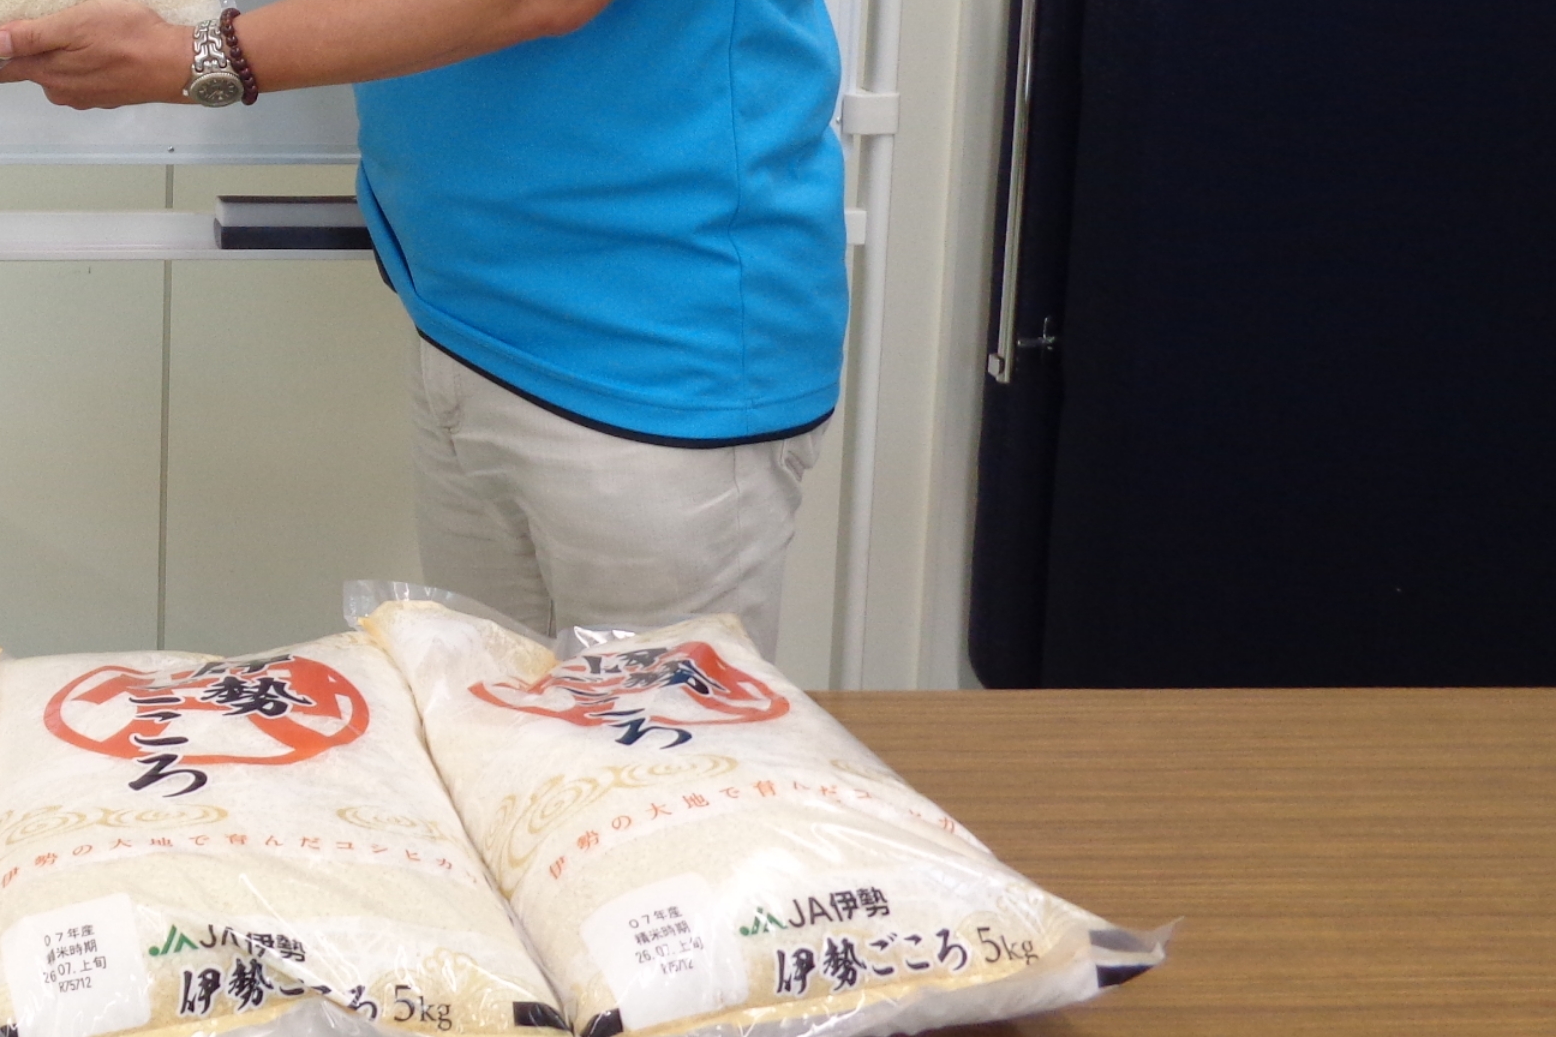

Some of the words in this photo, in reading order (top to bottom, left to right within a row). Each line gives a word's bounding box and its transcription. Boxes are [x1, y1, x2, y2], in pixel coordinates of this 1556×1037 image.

[789, 886, 891, 928] JA伊勢
[776, 927, 968, 995] 伊勢ごころ
[977, 926, 1040, 966] 5kg
[394, 984, 452, 1031] 5kg
